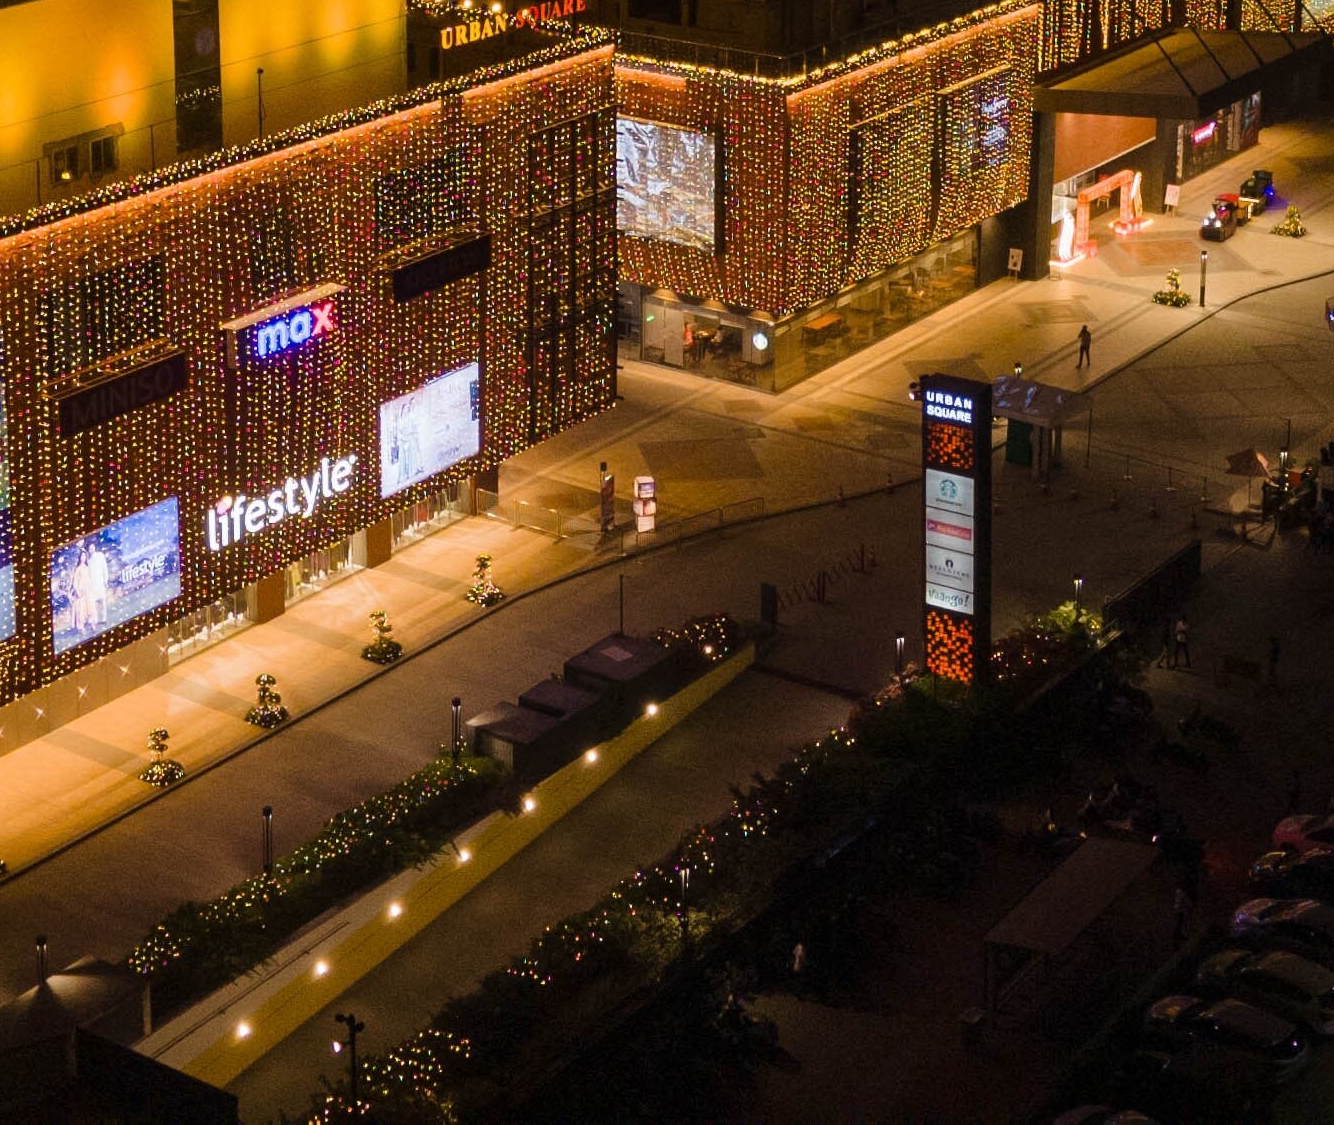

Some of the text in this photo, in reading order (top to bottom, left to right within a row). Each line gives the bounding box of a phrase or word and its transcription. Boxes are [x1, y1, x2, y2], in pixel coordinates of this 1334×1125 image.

[440, 13, 507, 50] URBAN
[257, 302, 339, 358] max
[71, 362, 175, 432] MINISO
[926, 390, 972, 410] URBAN
[926, 404, 972, 424] SQUARE
[207, 455, 355, 551] lifestyle
[121, 554, 166, 585] lifestyle
